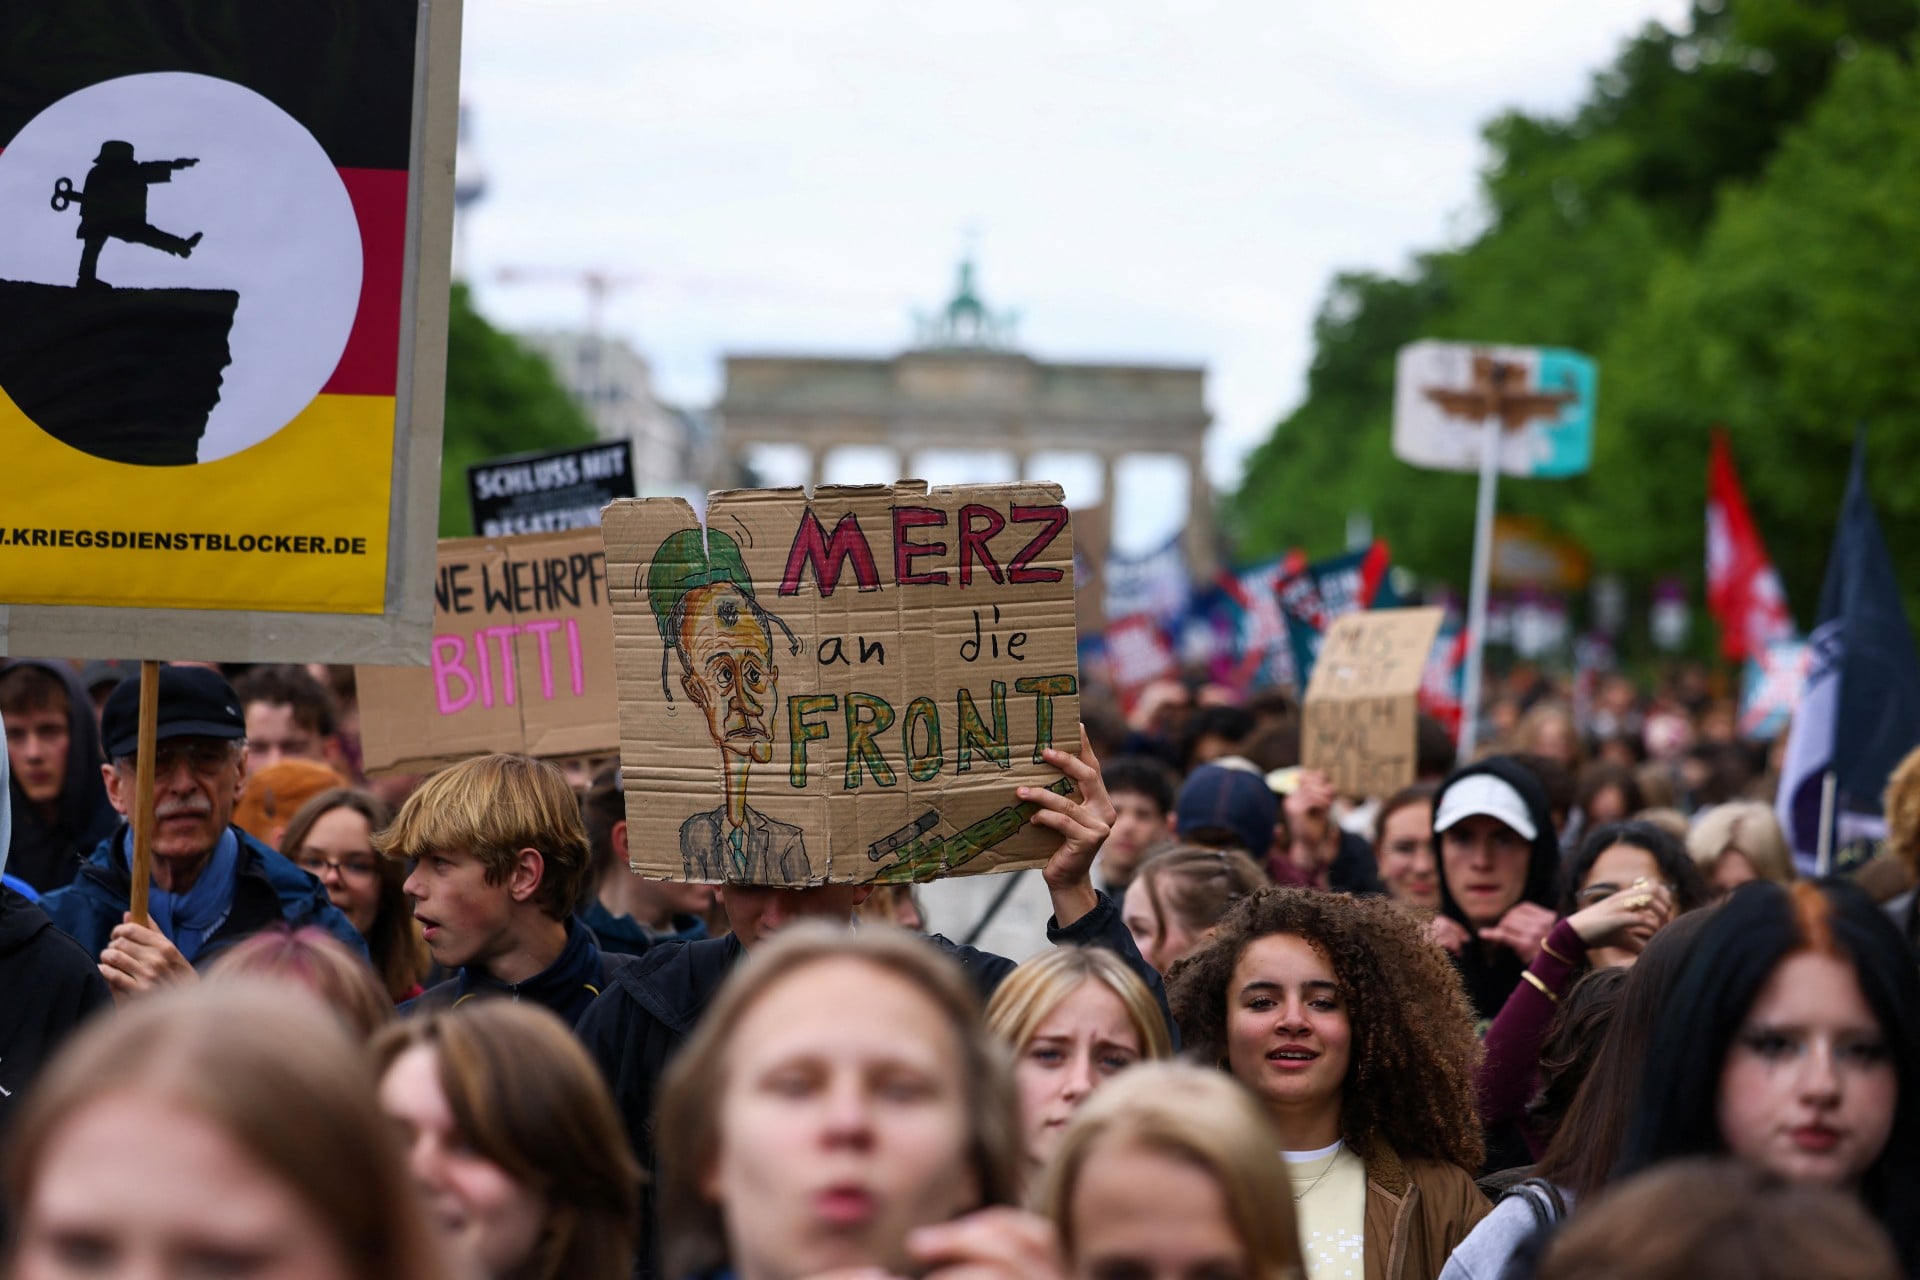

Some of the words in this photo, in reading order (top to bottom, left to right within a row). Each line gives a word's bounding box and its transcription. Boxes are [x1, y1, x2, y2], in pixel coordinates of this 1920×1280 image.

[475, 455, 580, 500] SCHLUSS
[580, 446, 626, 482] MIT
[0, 527, 367, 555] .KRIEGSDIENSTBLOCKER.DE
[777, 503, 1069, 598] MERZ
[481, 551, 612, 615] WEHRPF
[431, 617, 584, 716] BITTI
[817, 635, 885, 666] an
[959, 604, 1028, 663] die
[787, 673, 1077, 790] FRONT
